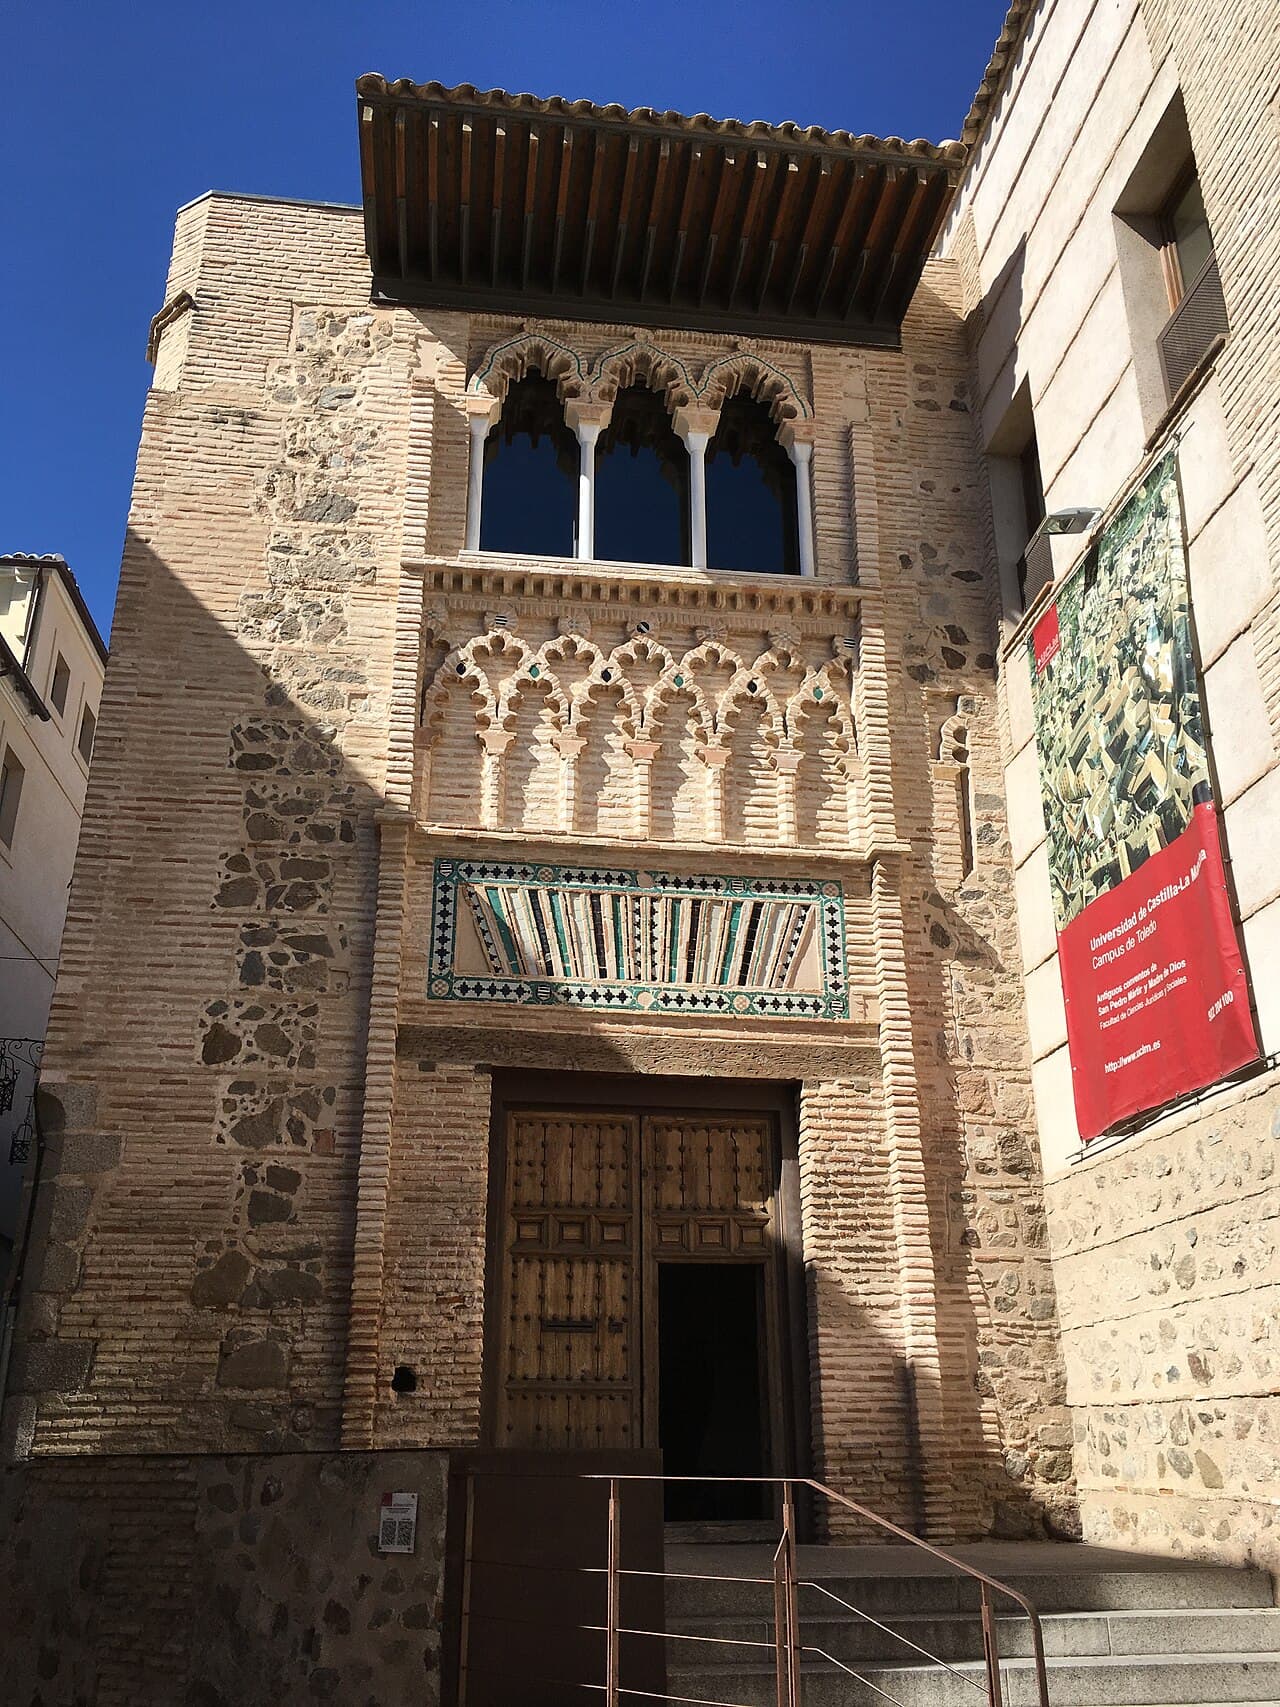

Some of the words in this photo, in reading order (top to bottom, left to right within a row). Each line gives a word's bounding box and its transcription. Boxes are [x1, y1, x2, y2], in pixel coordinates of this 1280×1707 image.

[1090, 912, 1137, 951] Universidad
[1138, 906, 1148, 921] de
[1147, 875, 1191, 912] Castilla-La
[1092, 944, 1125, 970] Campus
[1125, 936, 1136, 951] de
[1136, 920, 1157, 943] Toledo
[1096, 985, 1123, 1004] Antiguos
[1098, 1005, 1110, 1016] San
[1109, 996, 1128, 1011] Pedro
[1169, 959, 1187, 974] Dios
